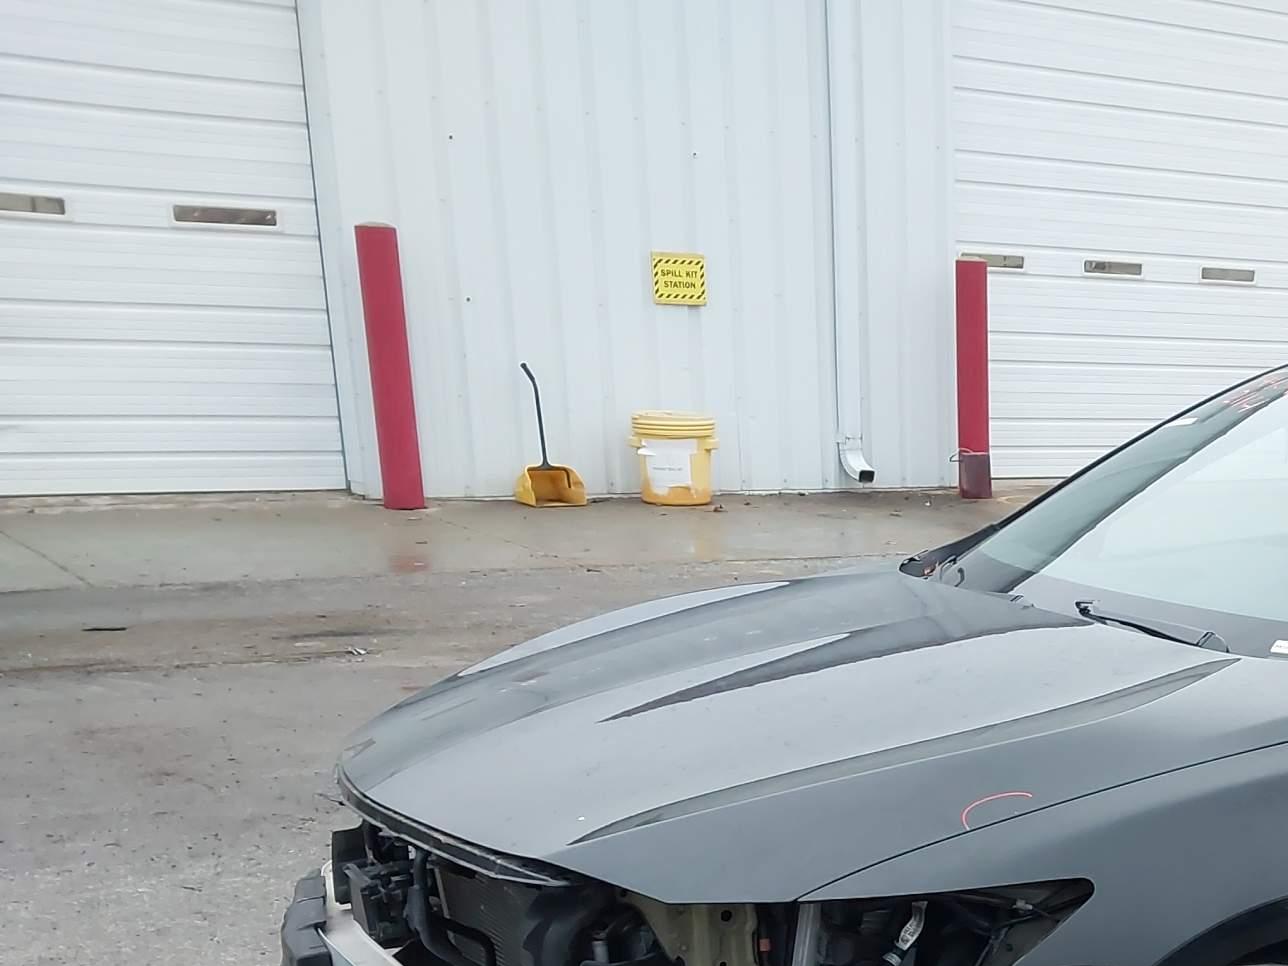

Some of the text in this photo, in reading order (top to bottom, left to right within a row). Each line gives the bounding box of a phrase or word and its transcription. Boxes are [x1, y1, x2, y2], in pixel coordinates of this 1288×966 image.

[660, 268, 698, 279] SPILL KIT
[663, 280, 696, 289] STATION
